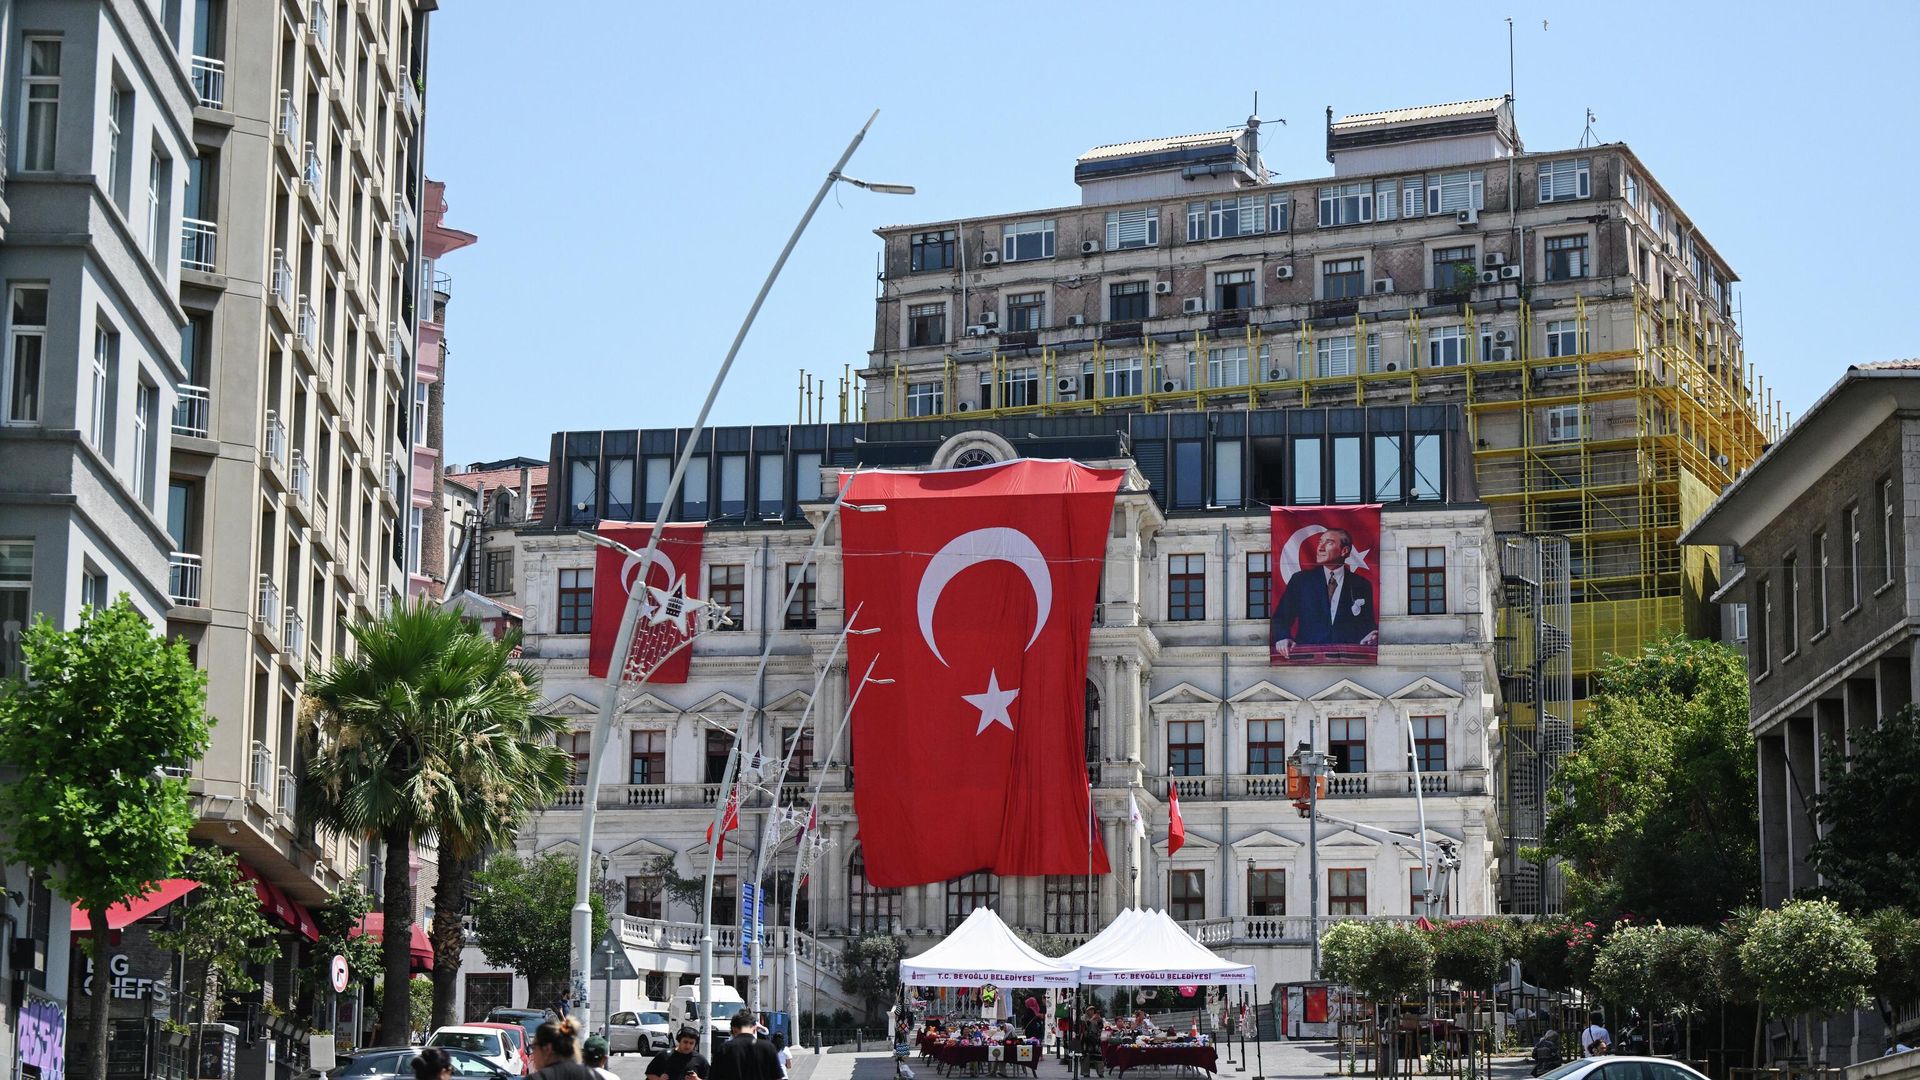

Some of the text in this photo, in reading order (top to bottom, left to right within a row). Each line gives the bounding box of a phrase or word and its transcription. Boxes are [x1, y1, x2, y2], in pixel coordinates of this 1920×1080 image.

[938, 972, 952, 980] T.C.
[954, 972, 989, 980] BEYOĞLU
[990, 973, 1035, 982] BELEDİYESİ
[1130, 972, 1165, 980] BEYOĞLU
[1167, 972, 1212, 980] BELEDİYESİ
